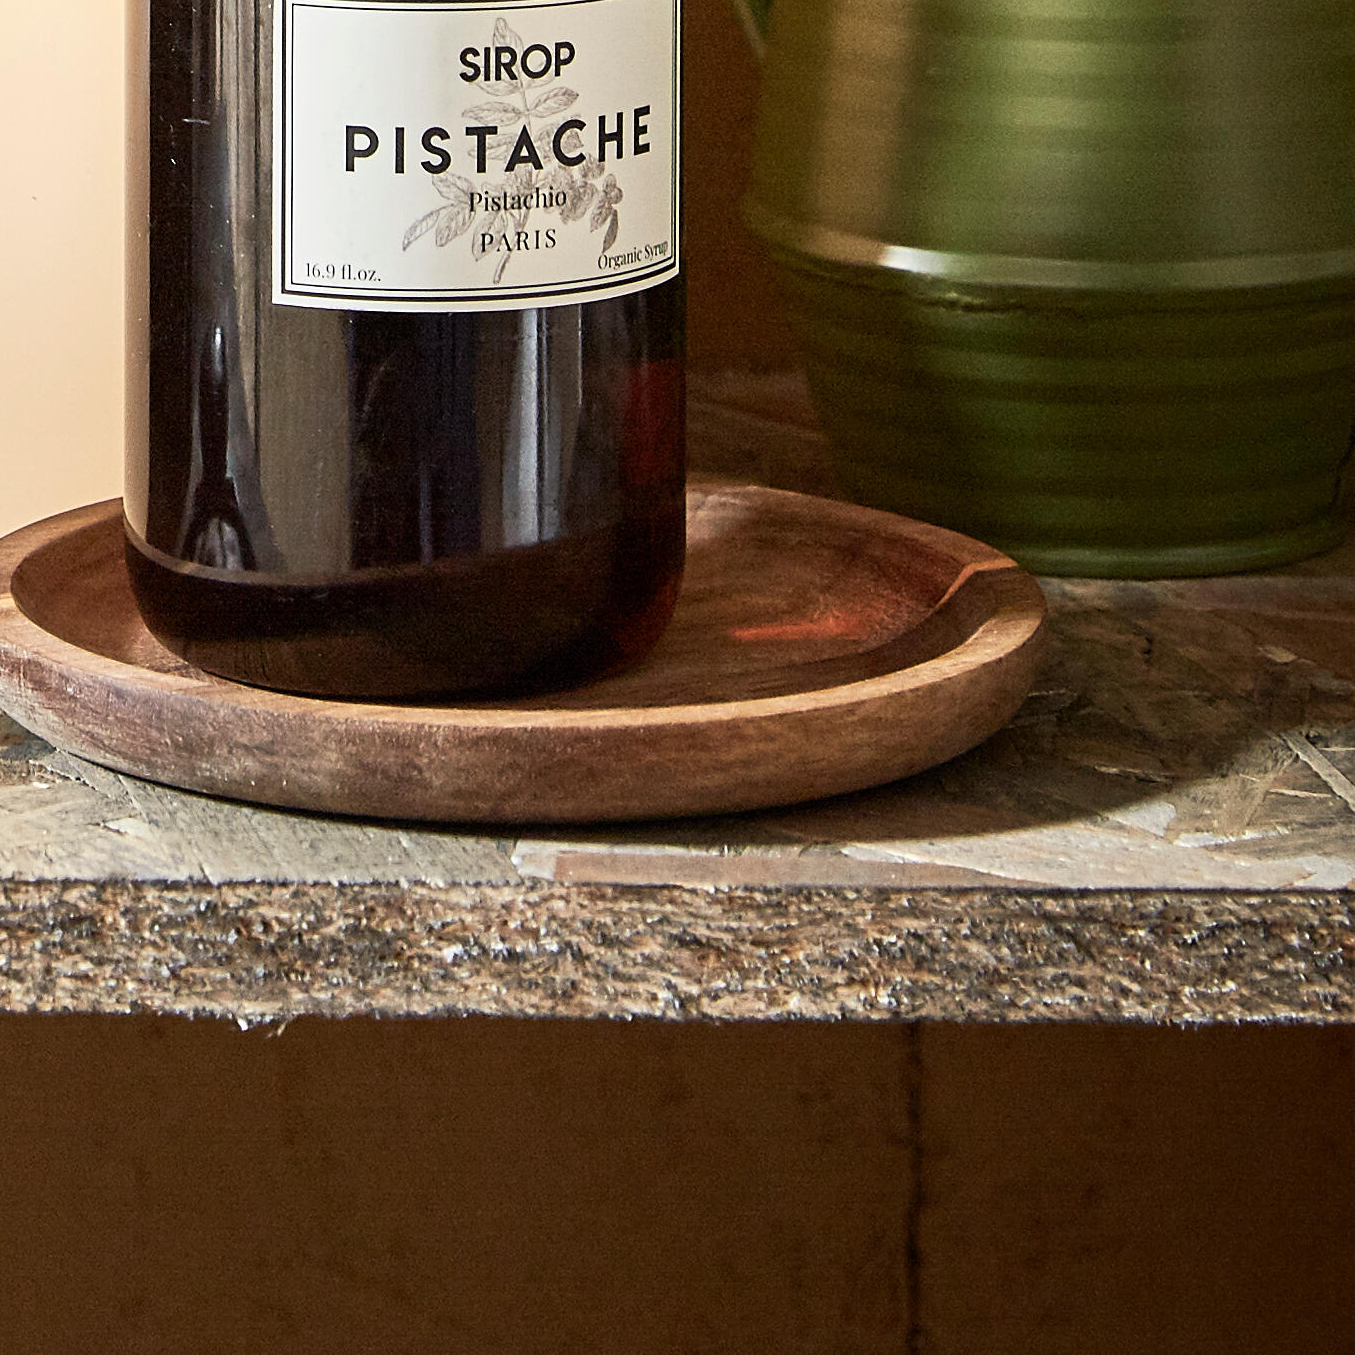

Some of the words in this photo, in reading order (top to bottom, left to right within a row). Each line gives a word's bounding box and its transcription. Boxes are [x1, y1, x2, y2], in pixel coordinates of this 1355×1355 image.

[459, 41, 576, 83] SIROP
[345, 105, 651, 174] PISTACHE
[469, 186, 567, 212] Pistachio
[480, 228, 557, 253] PARIS
[597, 246, 643, 270] Organic
[644, 240, 669, 261] Syrup
[305, 262, 336, 280] 16.9
[340, 263, 382, 282] fl.oz.
